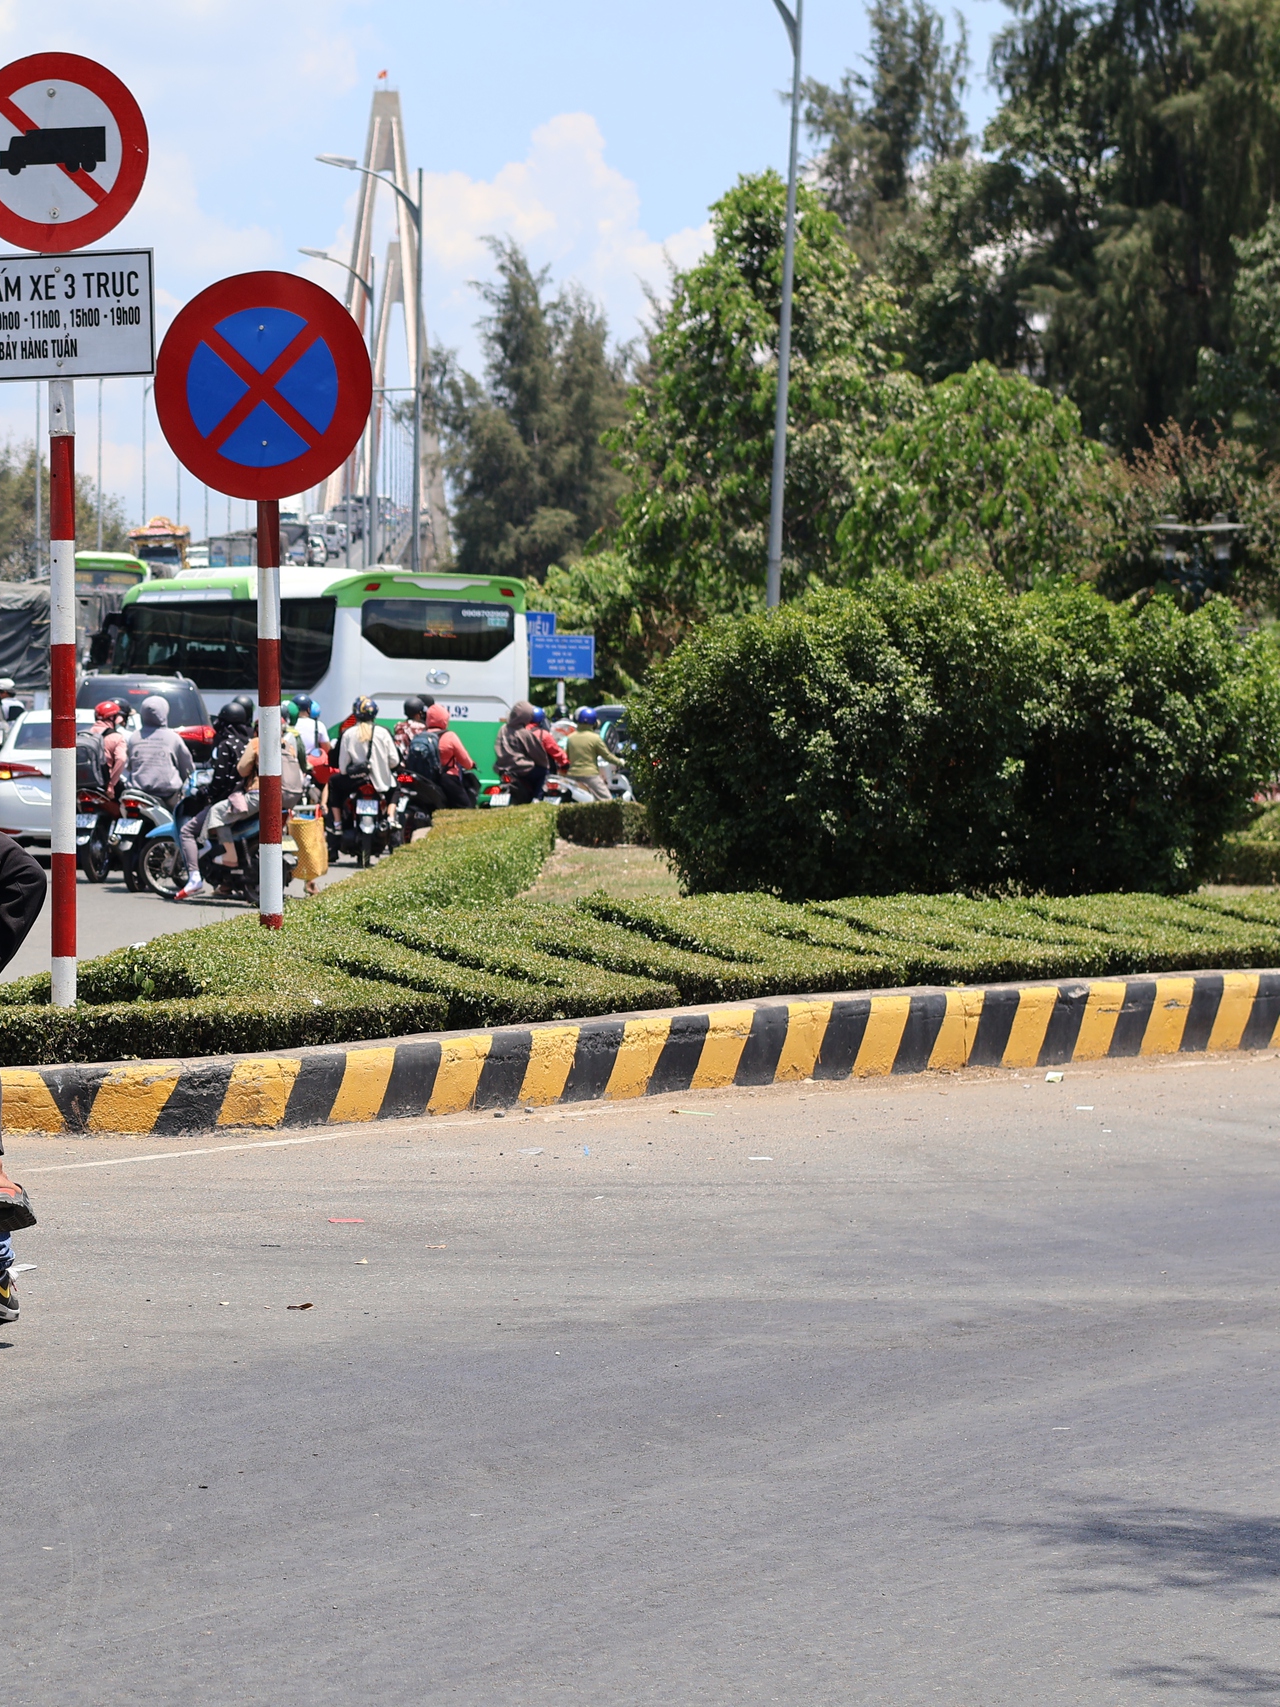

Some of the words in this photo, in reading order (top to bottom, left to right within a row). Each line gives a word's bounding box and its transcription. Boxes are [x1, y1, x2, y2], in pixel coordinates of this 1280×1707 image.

[30, 274, 56, 301] XE
[64, 273, 76, 300] 3
[83, 271, 139, 303] TRỤC
[30, 309, 60, 329] 11h00
[70, 308, 100, 328] 15h00
[110, 306, 141, 326] 19h00
[21, 337, 48, 360] HÀNG
[51, 333, 78, 359] TUẦN
